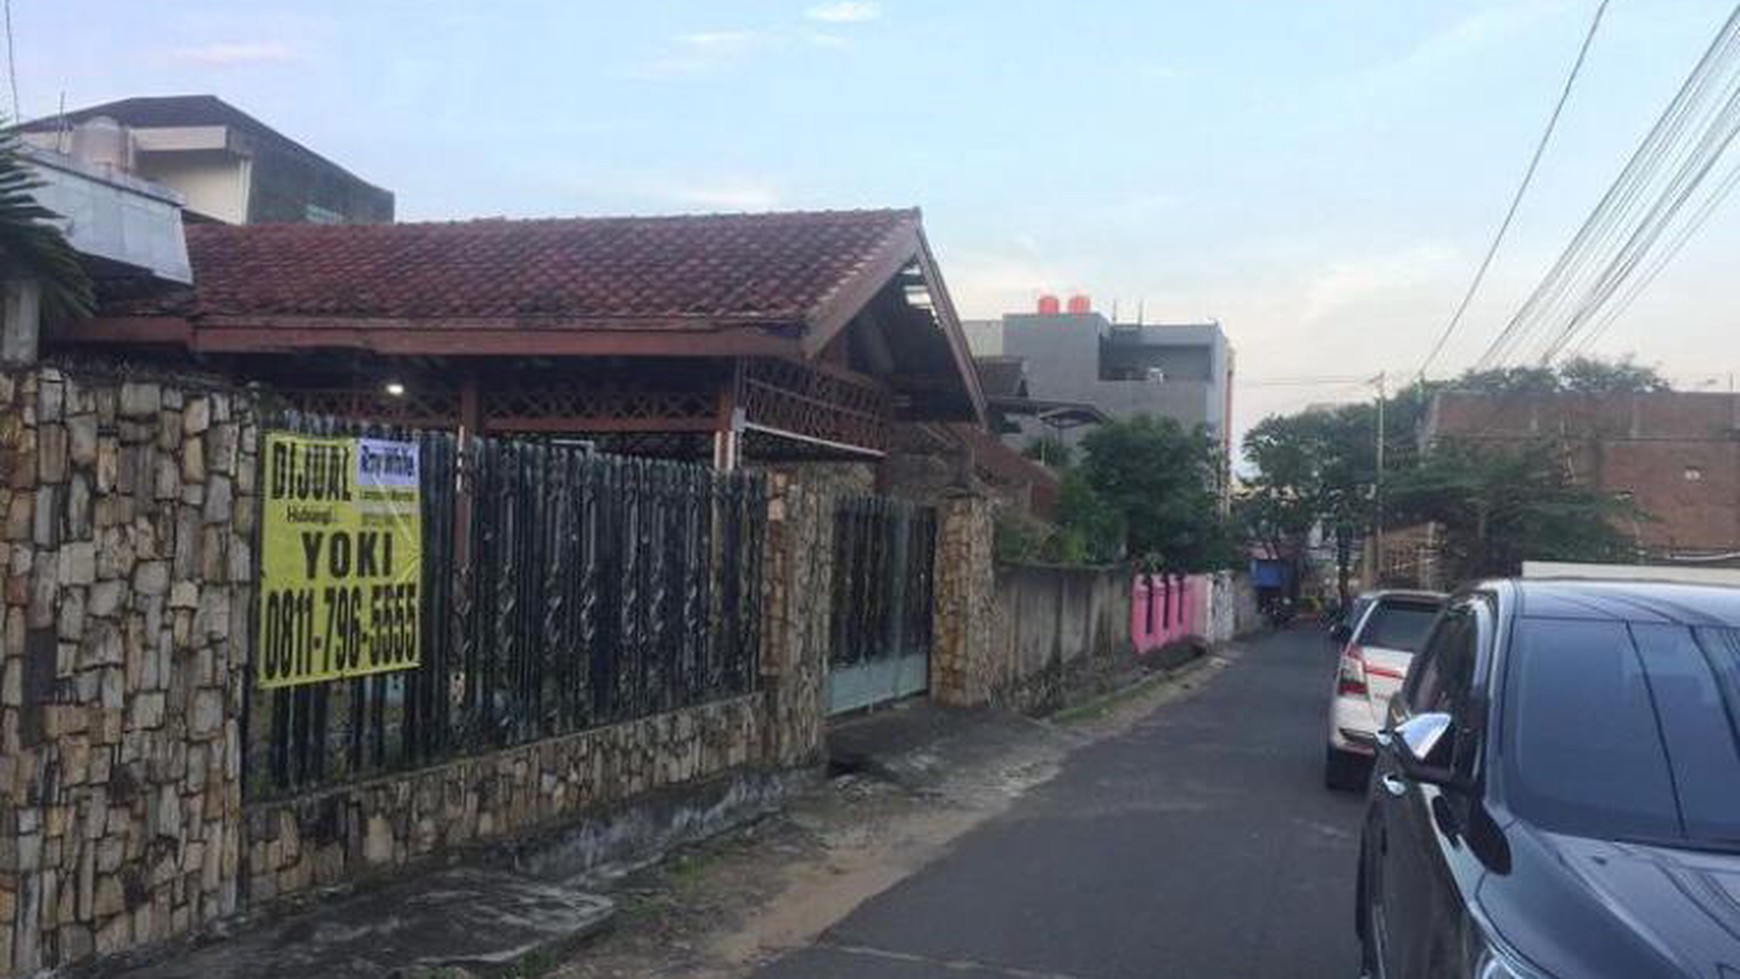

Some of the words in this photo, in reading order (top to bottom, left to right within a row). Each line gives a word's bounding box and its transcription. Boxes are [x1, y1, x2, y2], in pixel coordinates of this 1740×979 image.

[272, 441, 352, 502] DIJUAL
[301, 530, 394, 579] YOKI
[264, 583, 417, 680] 0811-796-5555
